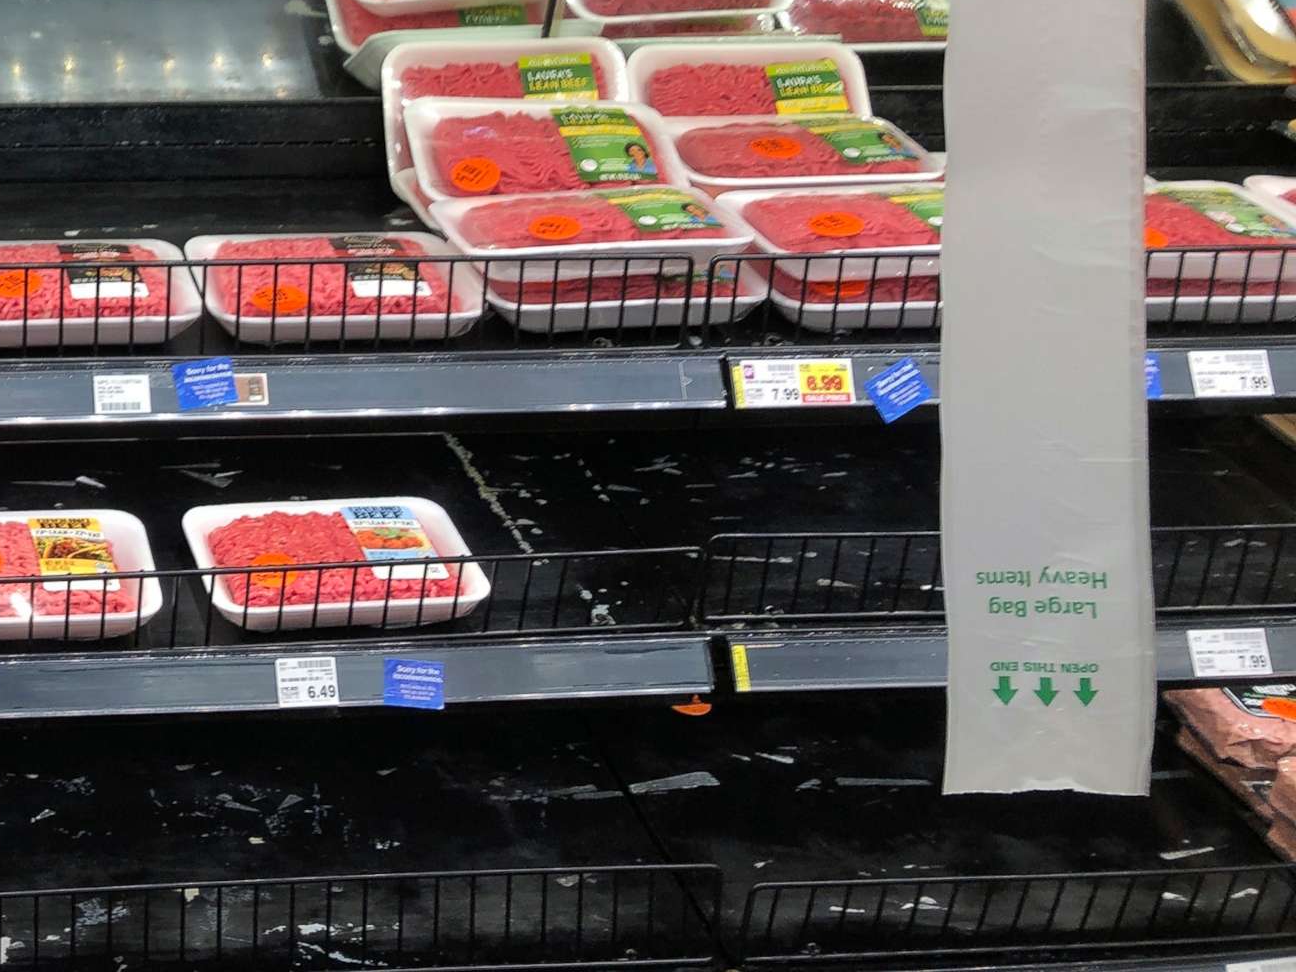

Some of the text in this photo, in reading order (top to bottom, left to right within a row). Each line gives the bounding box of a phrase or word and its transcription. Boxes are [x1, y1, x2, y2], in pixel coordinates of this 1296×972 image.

[976, 566, 1107, 589] Heavy Items
[989, 596, 1098, 619] Large Bag
[990, 661, 1099, 673] OPEN THIS END
[308, 685, 336, 699] 6.49
